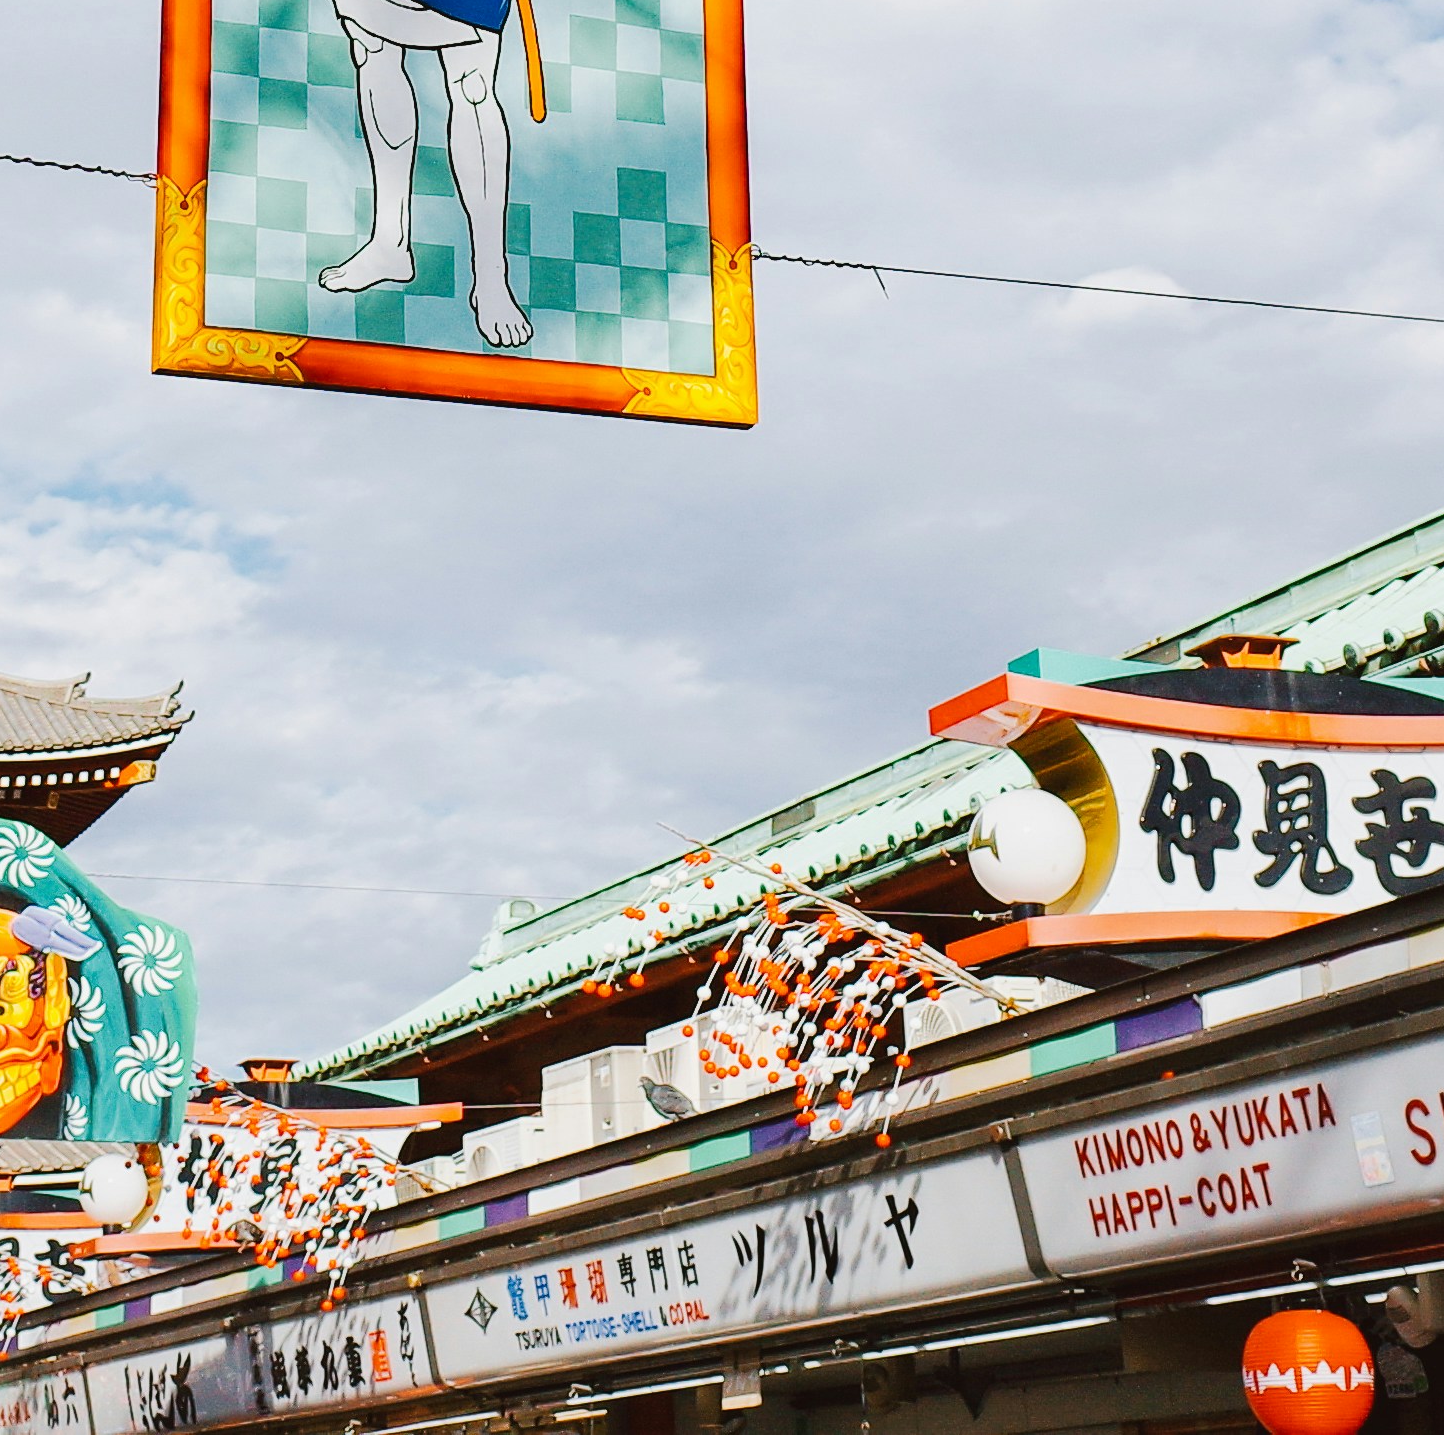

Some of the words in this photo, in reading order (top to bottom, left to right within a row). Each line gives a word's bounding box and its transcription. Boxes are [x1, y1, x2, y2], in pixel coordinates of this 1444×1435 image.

[1074, 1119, 1184, 1178] KIMONO
[1210, 1083, 1336, 1150] YUKATA
[1088, 1162, 1273, 1237] HAPPI-COAT
[731, 1194, 919, 1298] ツルヤ
[514, 1326, 564, 1351] TSURUYA
[565, 1309, 659, 1344] TORTOISE-SHELL
